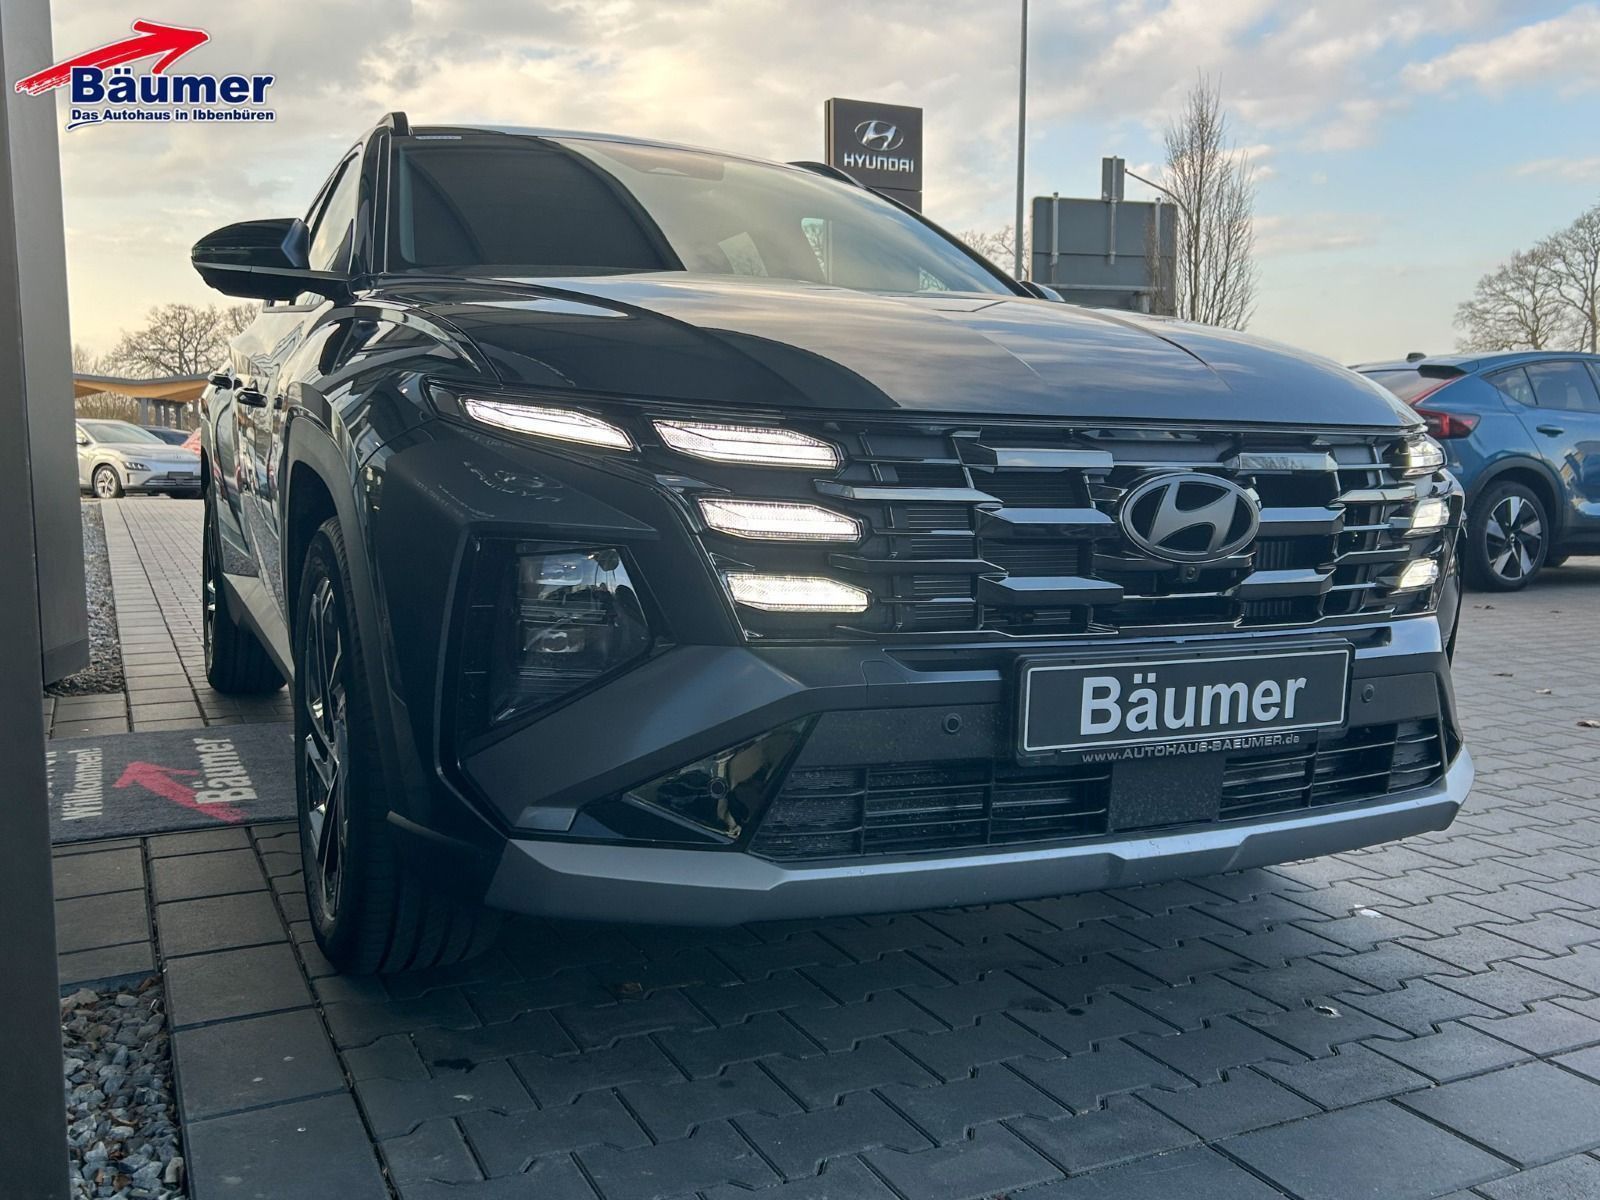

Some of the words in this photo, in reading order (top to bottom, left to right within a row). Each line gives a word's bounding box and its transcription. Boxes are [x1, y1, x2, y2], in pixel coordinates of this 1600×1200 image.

[843, 152, 914, 173] HYUNDAI
[1080, 672, 1307, 735] Bäumer
[61, 748, 103, 821] Willkommen!
[193, 738, 258, 804] Bäumer
